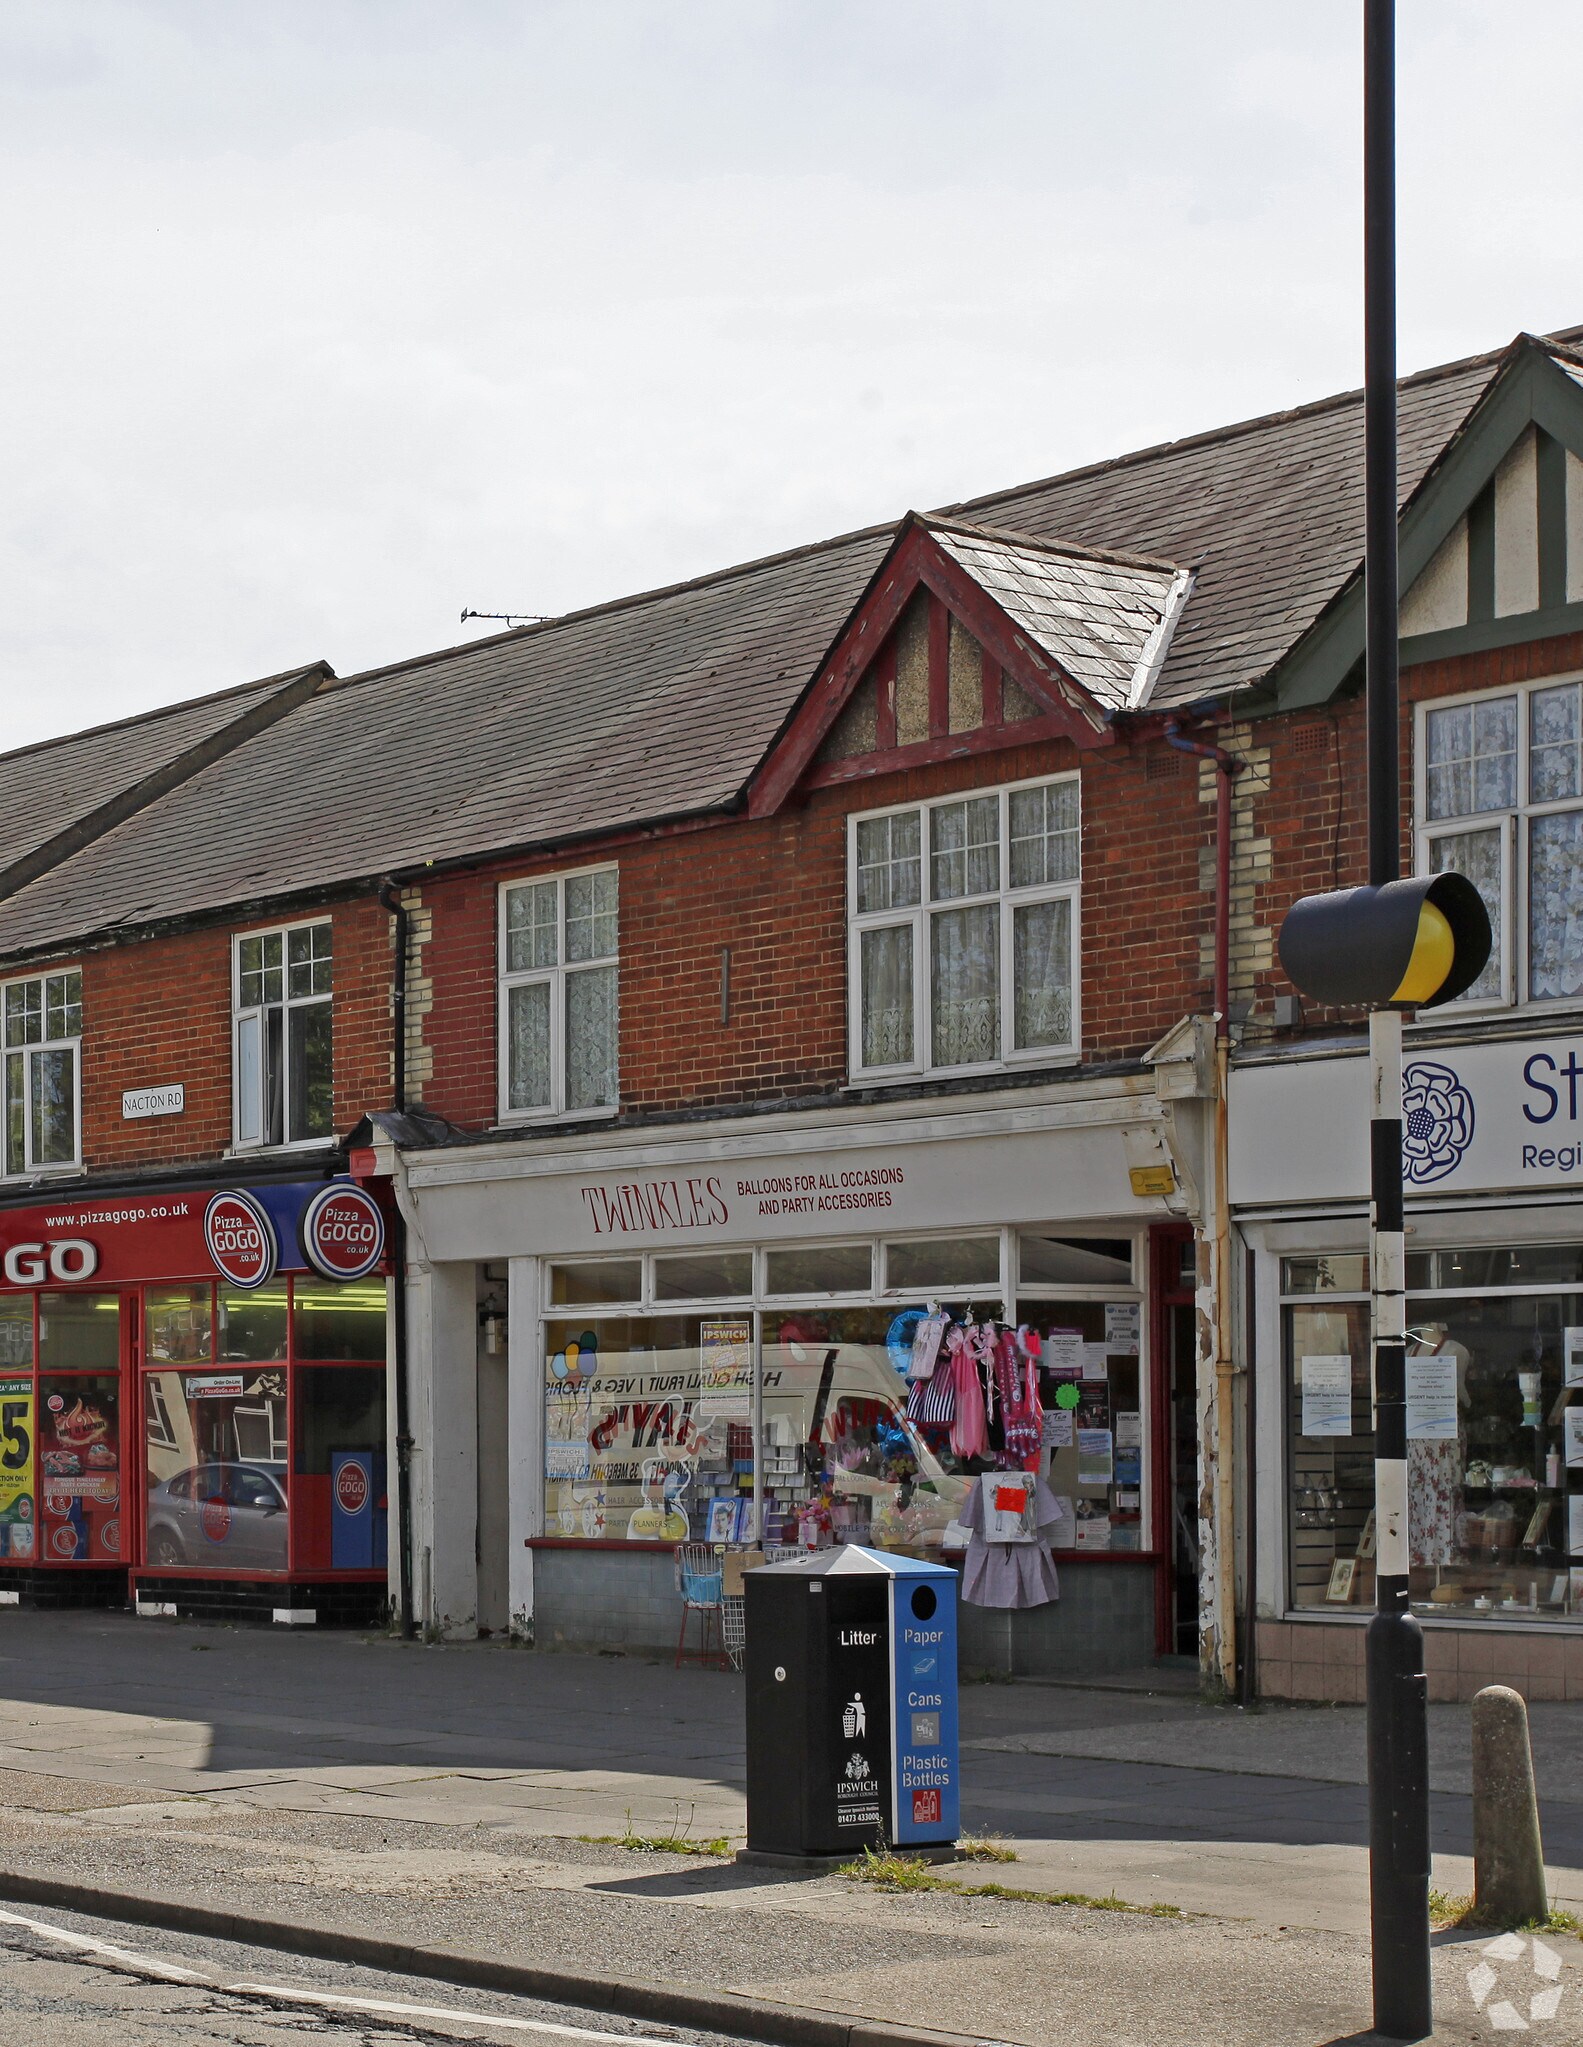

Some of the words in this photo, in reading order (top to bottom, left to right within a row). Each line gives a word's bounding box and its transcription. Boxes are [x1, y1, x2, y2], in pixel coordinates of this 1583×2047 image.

[124, 1094, 165, 1112] NACTON
[167, 1092, 182, 1106] RD
[737, 1177, 793, 1196] BALLOONS
[795, 1175, 816, 1191] FOR
[819, 1173, 838, 1189] ALL
[840, 1167, 904, 1187] OCCASIONS
[758, 1199, 780, 1215] AND
[782, 1197, 814, 1213] PARTY
[817, 1190, 892, 1211] ACCESSORIES
[45, 1202, 189, 1227] www.pizzagogo.co.uk
[325, 1208, 359, 1221] Pizza
[214, 1215, 243, 1229] Pizza
[319, 1222, 375, 1242] GOGO
[213, 1228, 260, 1251] GOGO
[344, 1244, 370, 1254] .co.uk
[239, 1252, 260, 1263] .co.uk
[703, 1330, 747, 1340] IPSWICH
[341, 1472, 358, 1482] Pizza
[339, 1481, 365, 1494] GOGO
[608, 1497, 625, 1505] HAIR
[608, 1519, 629, 1528] PARTY
[834, 1524, 859, 1532] MOBILE
[841, 1630, 877, 1646] Litter
[904, 1629, 943, 1646] Paper
[908, 1691, 942, 1707] Cans
[903, 1754, 948, 1770] Plastic
[902, 1771, 949, 1787] Bottles
[837, 1780, 878, 1793] IPSWICH
[837, 1814, 857, 1823] 01473
[857, 1812, 880, 1822] 433000
